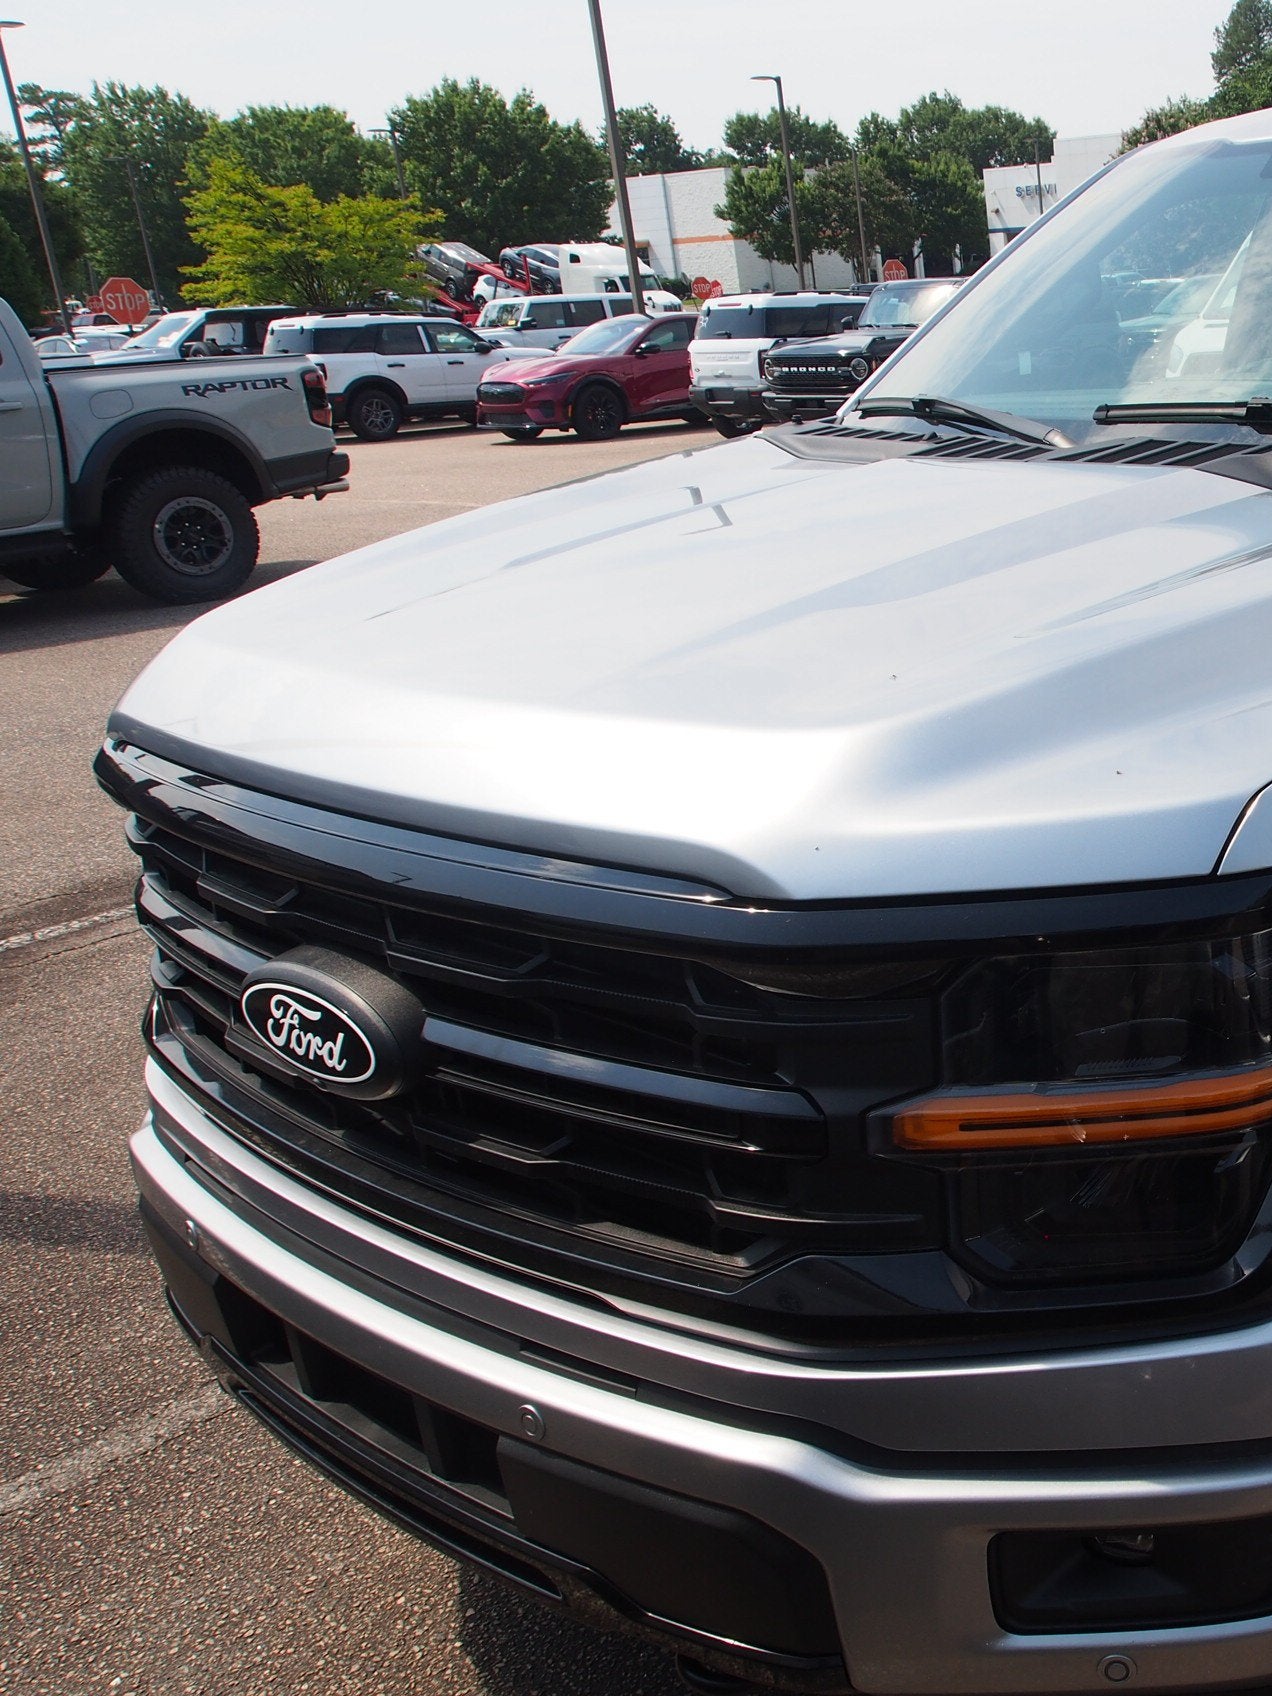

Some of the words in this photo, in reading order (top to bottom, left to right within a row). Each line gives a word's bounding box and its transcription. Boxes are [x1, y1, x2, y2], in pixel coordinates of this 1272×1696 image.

[884, 270, 905, 281] STOP
[693, 283, 711, 294] STOP
[105, 293, 144, 310] STOP
[181, 377, 295, 399] RAPTOR
[267, 994, 347, 1072] Ford
